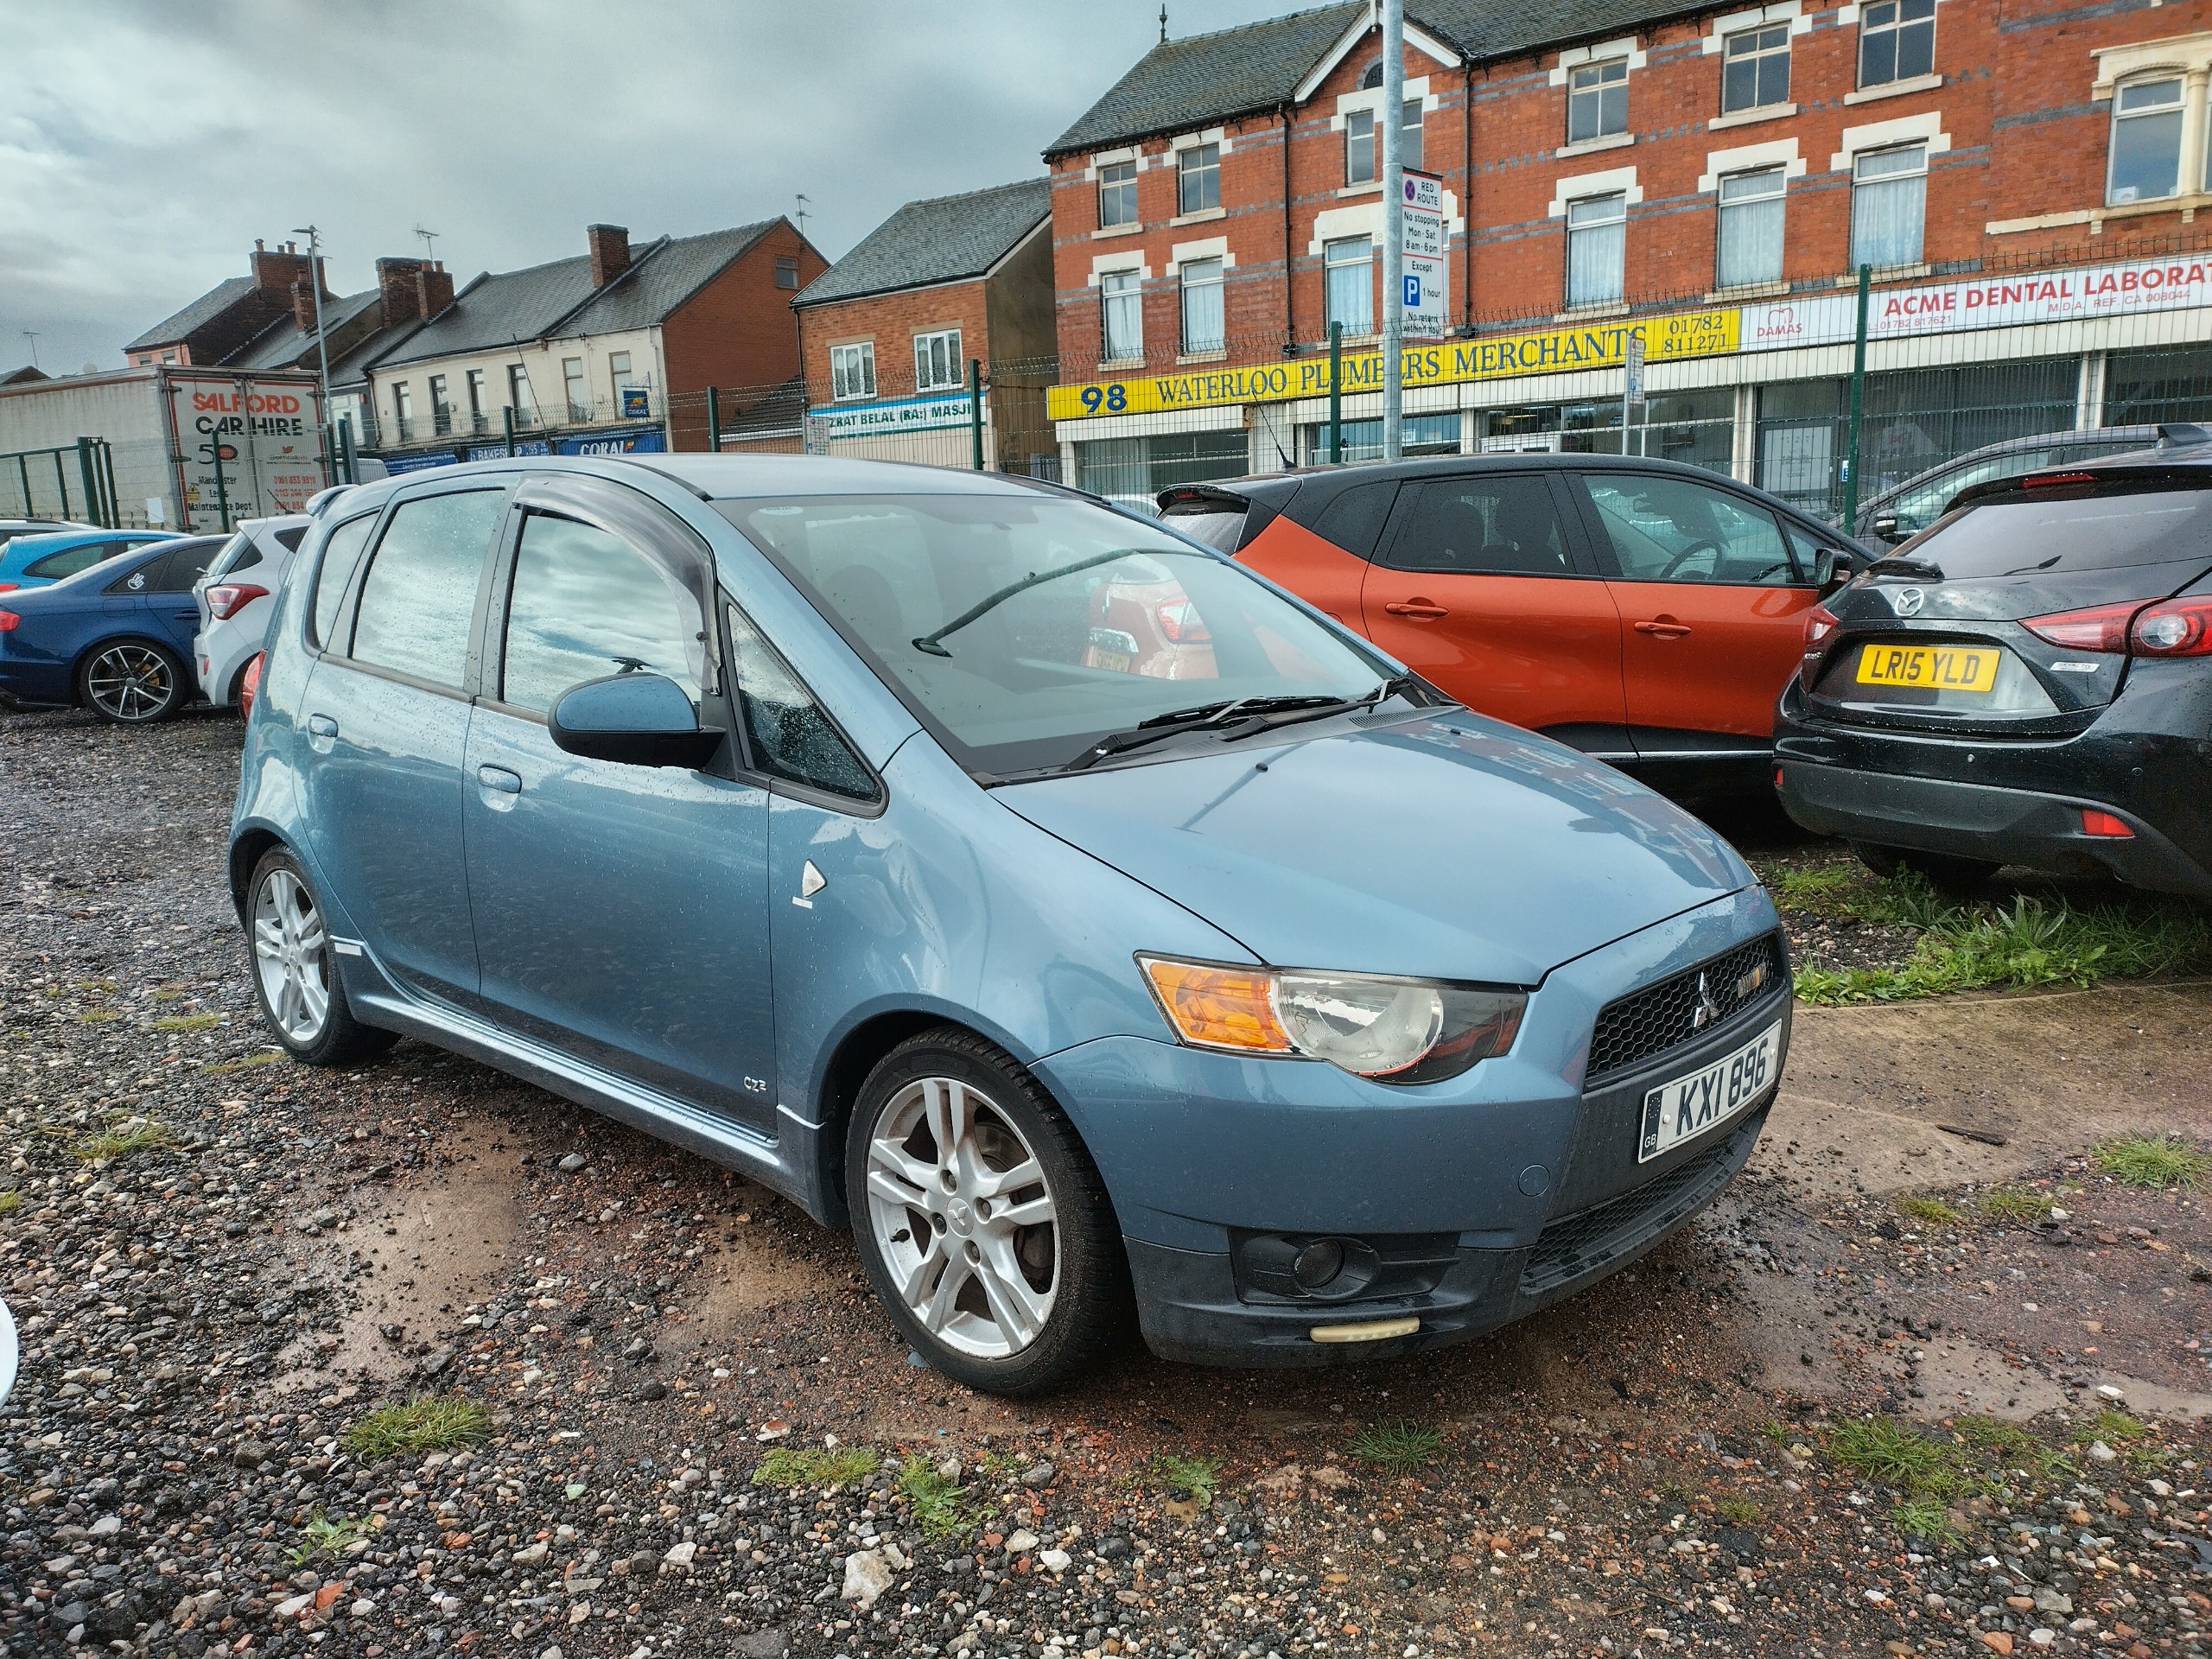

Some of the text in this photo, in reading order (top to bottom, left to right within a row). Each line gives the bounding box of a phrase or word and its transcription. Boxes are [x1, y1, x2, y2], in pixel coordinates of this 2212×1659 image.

[1421, 181, 1434, 193] RED
[1417, 193, 1438, 206] ROUTE
[1403, 211, 1440, 228] No stopping
[1408, 226, 1421, 237] Mon
[1426, 230, 1436, 240] Sat
[1412, 261, 1433, 273] Except
[1407, 278, 1441, 302] P 1 hour
[1884, 292, 1956, 316] ACME
[1966, 278, 2073, 308] DENTAL
[2093, 297, 2120, 308] REF.
[2124, 295, 2141, 305] CA
[2145, 290, 2191, 302] 008044
[1408, 312, 1438, 323] No return
[1669, 315, 1723, 334] 01782
[1879, 320, 1911, 330] 01782
[1914, 315, 1951, 327] 817621
[1403, 323, 1422, 334] within
[1428, 325, 1442, 335] hour
[1757, 323, 1802, 338] DAMAS
[1664, 334, 1726, 353] 811271
[1081, 384, 1127, 413] 98
[1155, 367, 1287, 404] WATERLOO
[1300, 350, 1440, 391] PLMBRS
[192, 392, 300, 413] SALFORD
[830, 415, 857, 428] ZRAT
[861, 411, 895, 425] BELAL
[931, 404, 971, 418] MASJI
[195, 416, 302, 435] CAR HIRE
[580, 441, 624, 454] CORAL
[199, 475, 237, 484] Mancster
[209, 489, 229, 498] Les
[188, 502, 252, 512] Maintenace Dept
[1871, 649, 1980, 684] LR15 YLD
[743, 1076, 767, 1092] CZ2
[1676, 1037, 1769, 1137] KXI 896
[1644, 1133, 1657, 1148] GB
